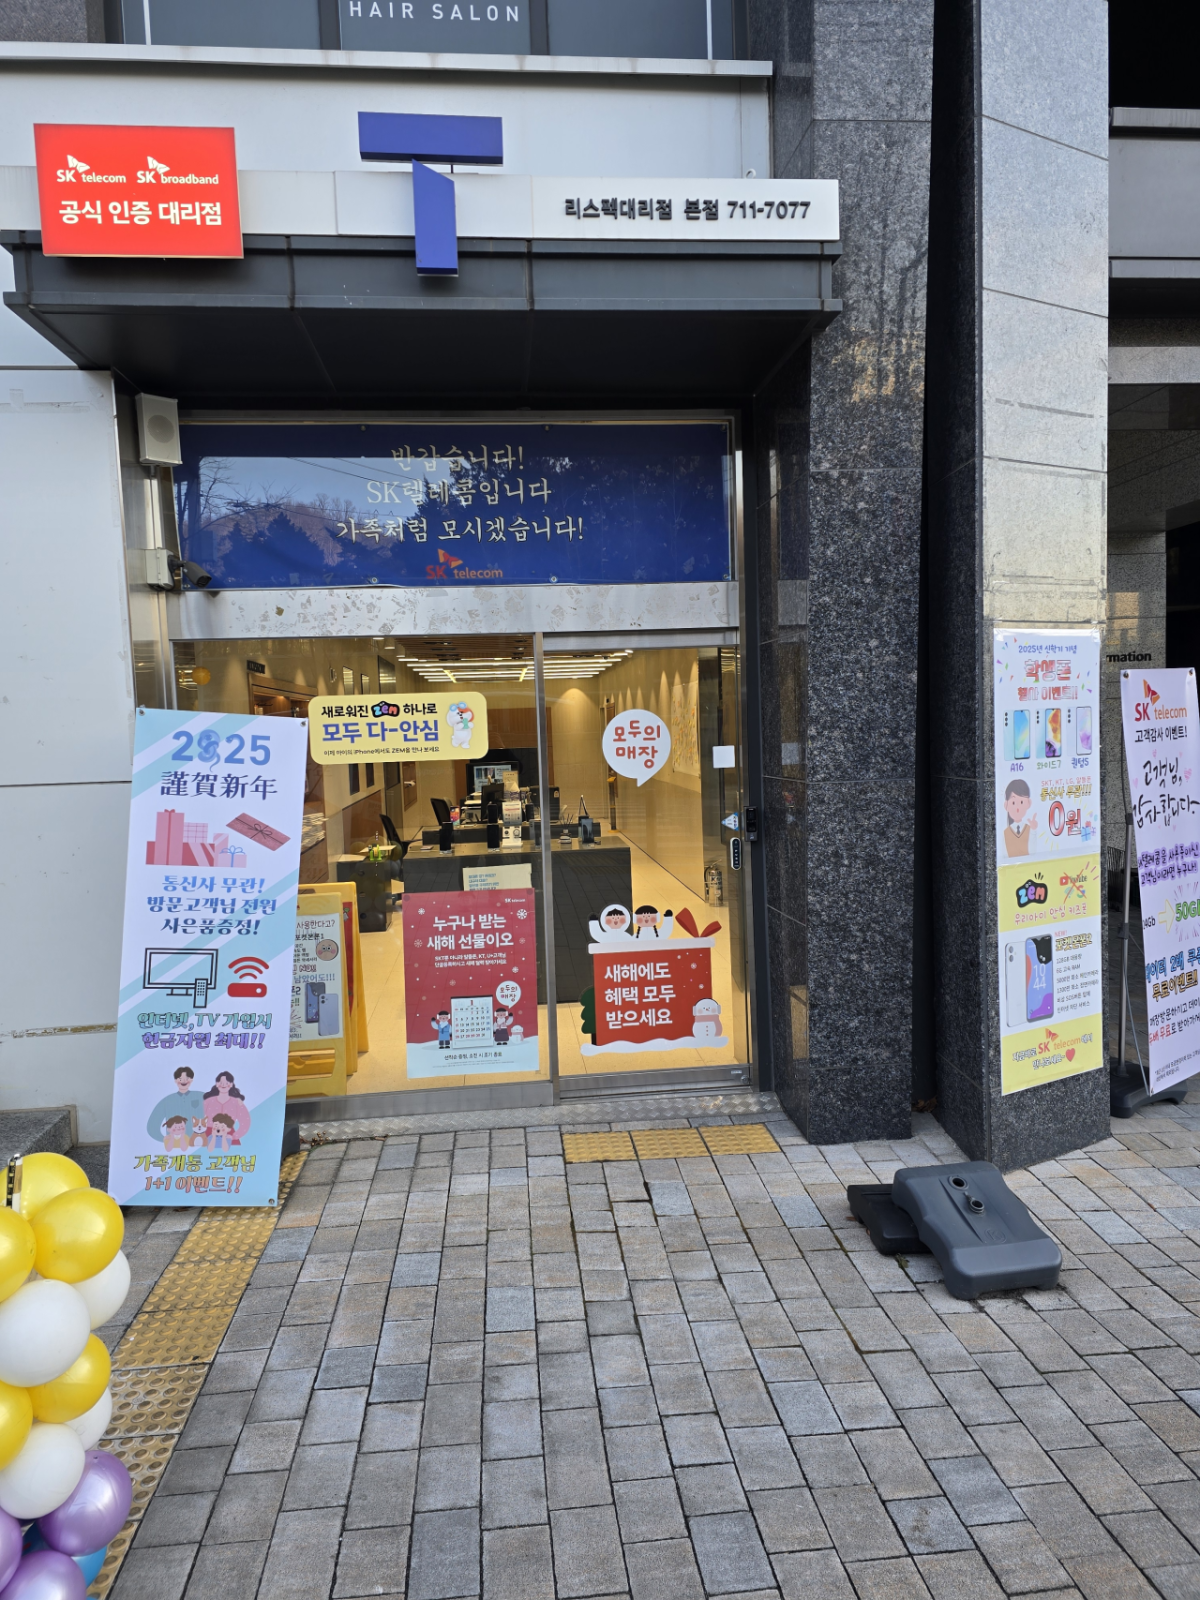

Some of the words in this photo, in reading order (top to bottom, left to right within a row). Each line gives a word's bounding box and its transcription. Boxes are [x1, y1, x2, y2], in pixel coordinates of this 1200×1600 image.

[349, 1, 414, 19] HAIR
[432, 4, 519, 22] SALON
[56, 169, 77, 183] SK
[81, 172, 127, 183] telecom
[136, 170, 157, 184] SK
[160, 173, 219, 185] broadband
[58, 200, 102, 225] 공식
[108, 200, 152, 225] 인증
[158, 201, 222, 226] 대리점
[564, 198, 673, 221] 리스펙대리점
[683, 198, 719, 221] 본점
[727, 200, 811, 219] 711-7077
[391, 445, 524, 472] 반갑습니다!
[367, 477, 551, 505] SK텔레콤입니다
[336, 516, 428, 544] 가족처럼
[437, 515, 584, 543] 모시겠습니다!
[426, 565, 448, 579] SK
[453, 566, 503, 579] telecom
[1018, 644, 1043, 654] 2025년
[1044, 644, 1063, 654] 신학기
[1065, 644, 1077, 654] 기념
[321, 705, 369, 718] 새로워진
[403, 703, 438, 715] 하나로
[1134, 702, 1151, 722] SK
[1154, 704, 1188, 720] telecom
[322, 722, 362, 743] 모두
[366, 719, 439, 743] 다-안심
[613, 720, 661, 742] 모두의
[1134, 727, 1164, 743] 고객감사
[1165, 725, 1188, 741] 이벤트!
[615, 745, 658, 769] 매장
[1010, 762, 1024, 772] A16
[1036, 760, 1062, 770] 와이드7
[160, 770, 278, 800] 謹賀新年
[1048, 800, 1082, 837] 0원
[162, 875, 217, 893] 통신사
[221, 877, 266, 894] 무관!
[147, 896, 236, 915] 방문고객님
[240, 898, 277, 915] 전원
[296, 919, 336, 930] 사용한다고?
[433, 914, 476, 931] 누구나
[478, 913, 507, 930] 받는
[1015, 910, 1047, 926] 우리아이
[1049, 905, 1066, 920] 안심
[161, 917, 261, 936] 사은품증정!
[426, 934, 455, 951] 새해
[458, 932, 514, 950] 선물이오
[604, 962, 671, 983] 새해에도
[1033, 963, 1046, 977] 10
[1033, 977, 1046, 990] 44
[604, 986, 639, 1006] 혜택
[642, 984, 676, 1003] 모두
[137, 1012, 221, 1030] 인터넷,TV
[222, 1012, 272, 1029] 가입시
[605, 1008, 673, 1030] 받으세요
[142, 1032, 211, 1049] 현금지원
[214, 1032, 265, 1049] 최대!!
[1038, 1041, 1050, 1054] SK
[134, 1155, 203, 1172] 가족개통
[205, 1155, 257, 1172] 고객님
[145, 1176, 172, 1191] 1+1
[175, 1176, 243, 1193] 이벤트!!
